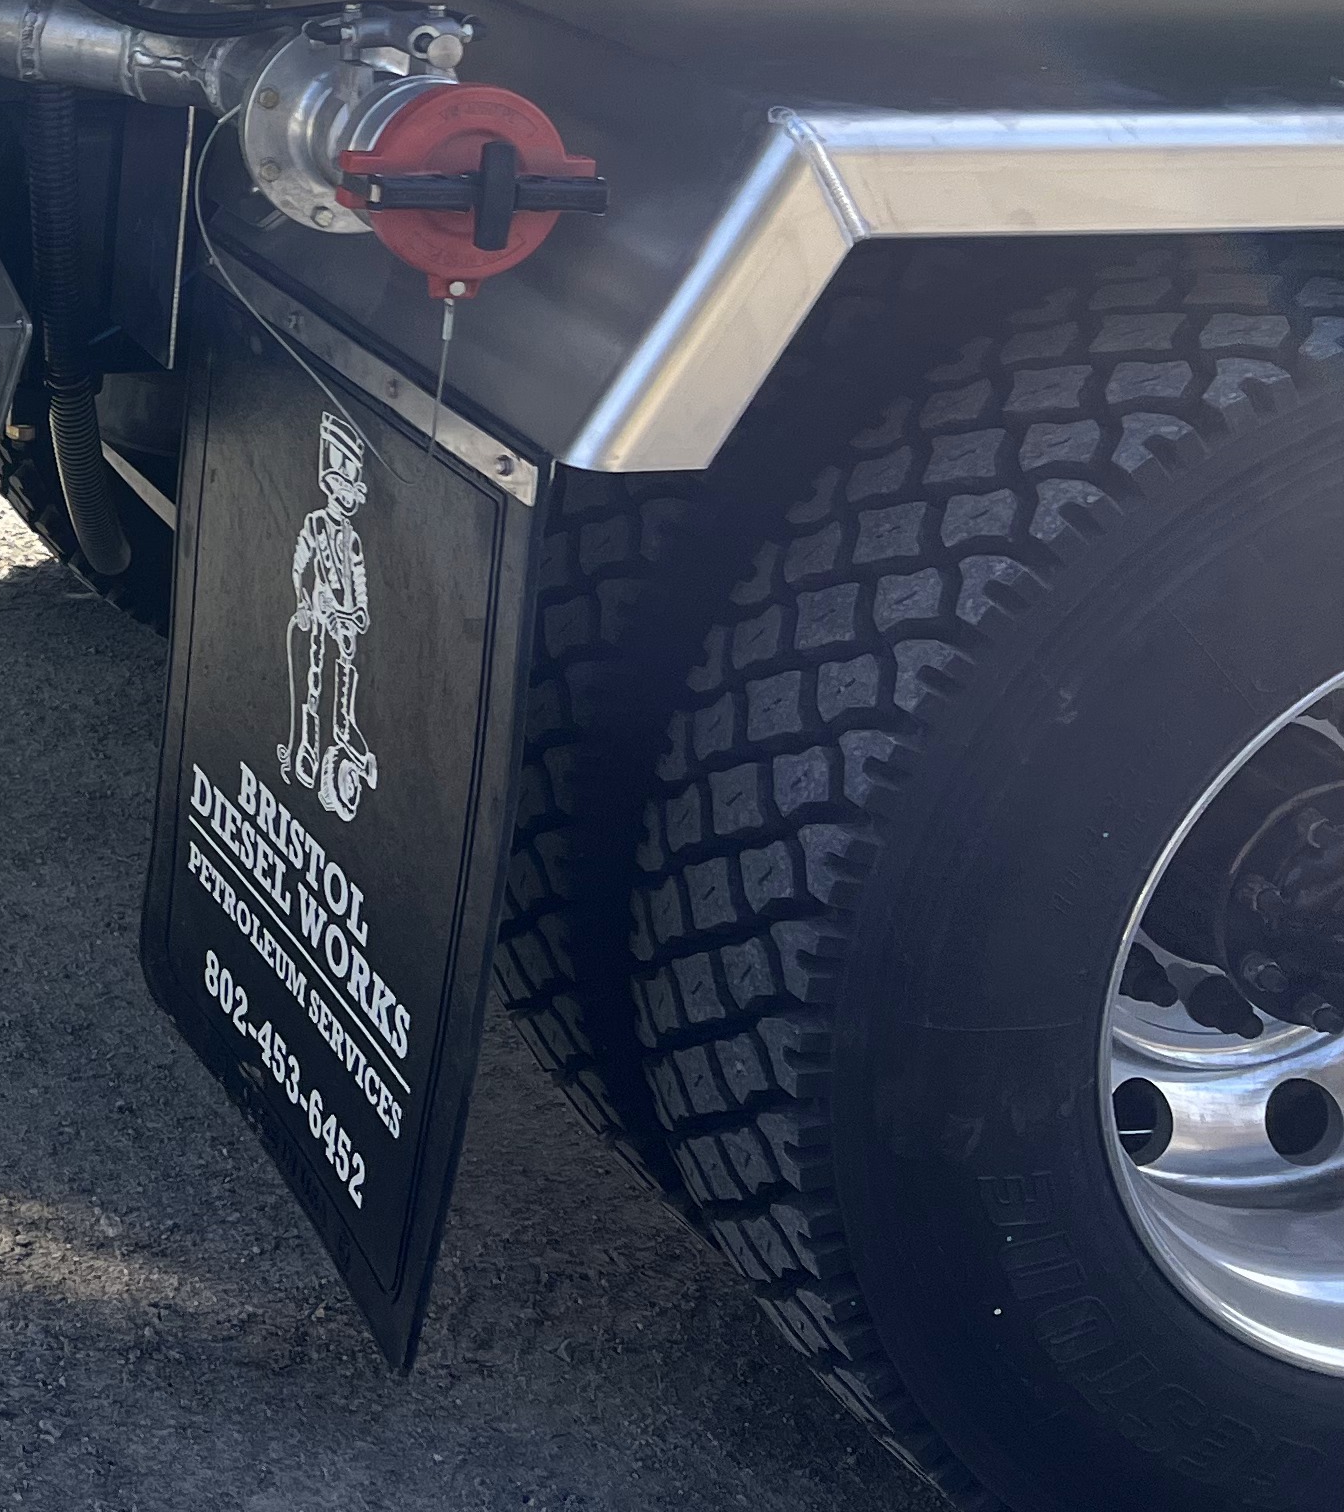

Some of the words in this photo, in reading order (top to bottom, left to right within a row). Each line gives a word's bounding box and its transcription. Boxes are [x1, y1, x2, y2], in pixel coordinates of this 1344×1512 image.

[187, 841, 307, 1008] PETROLEUM
[308, 989, 403, 1139] SERVICES
[190, 763, 292, 916] DIESEL
[297, 882, 411, 1060] WORKS
[237, 761, 368, 948] BRISTOL
[204, 949, 366, 1210] 802-453-6452
